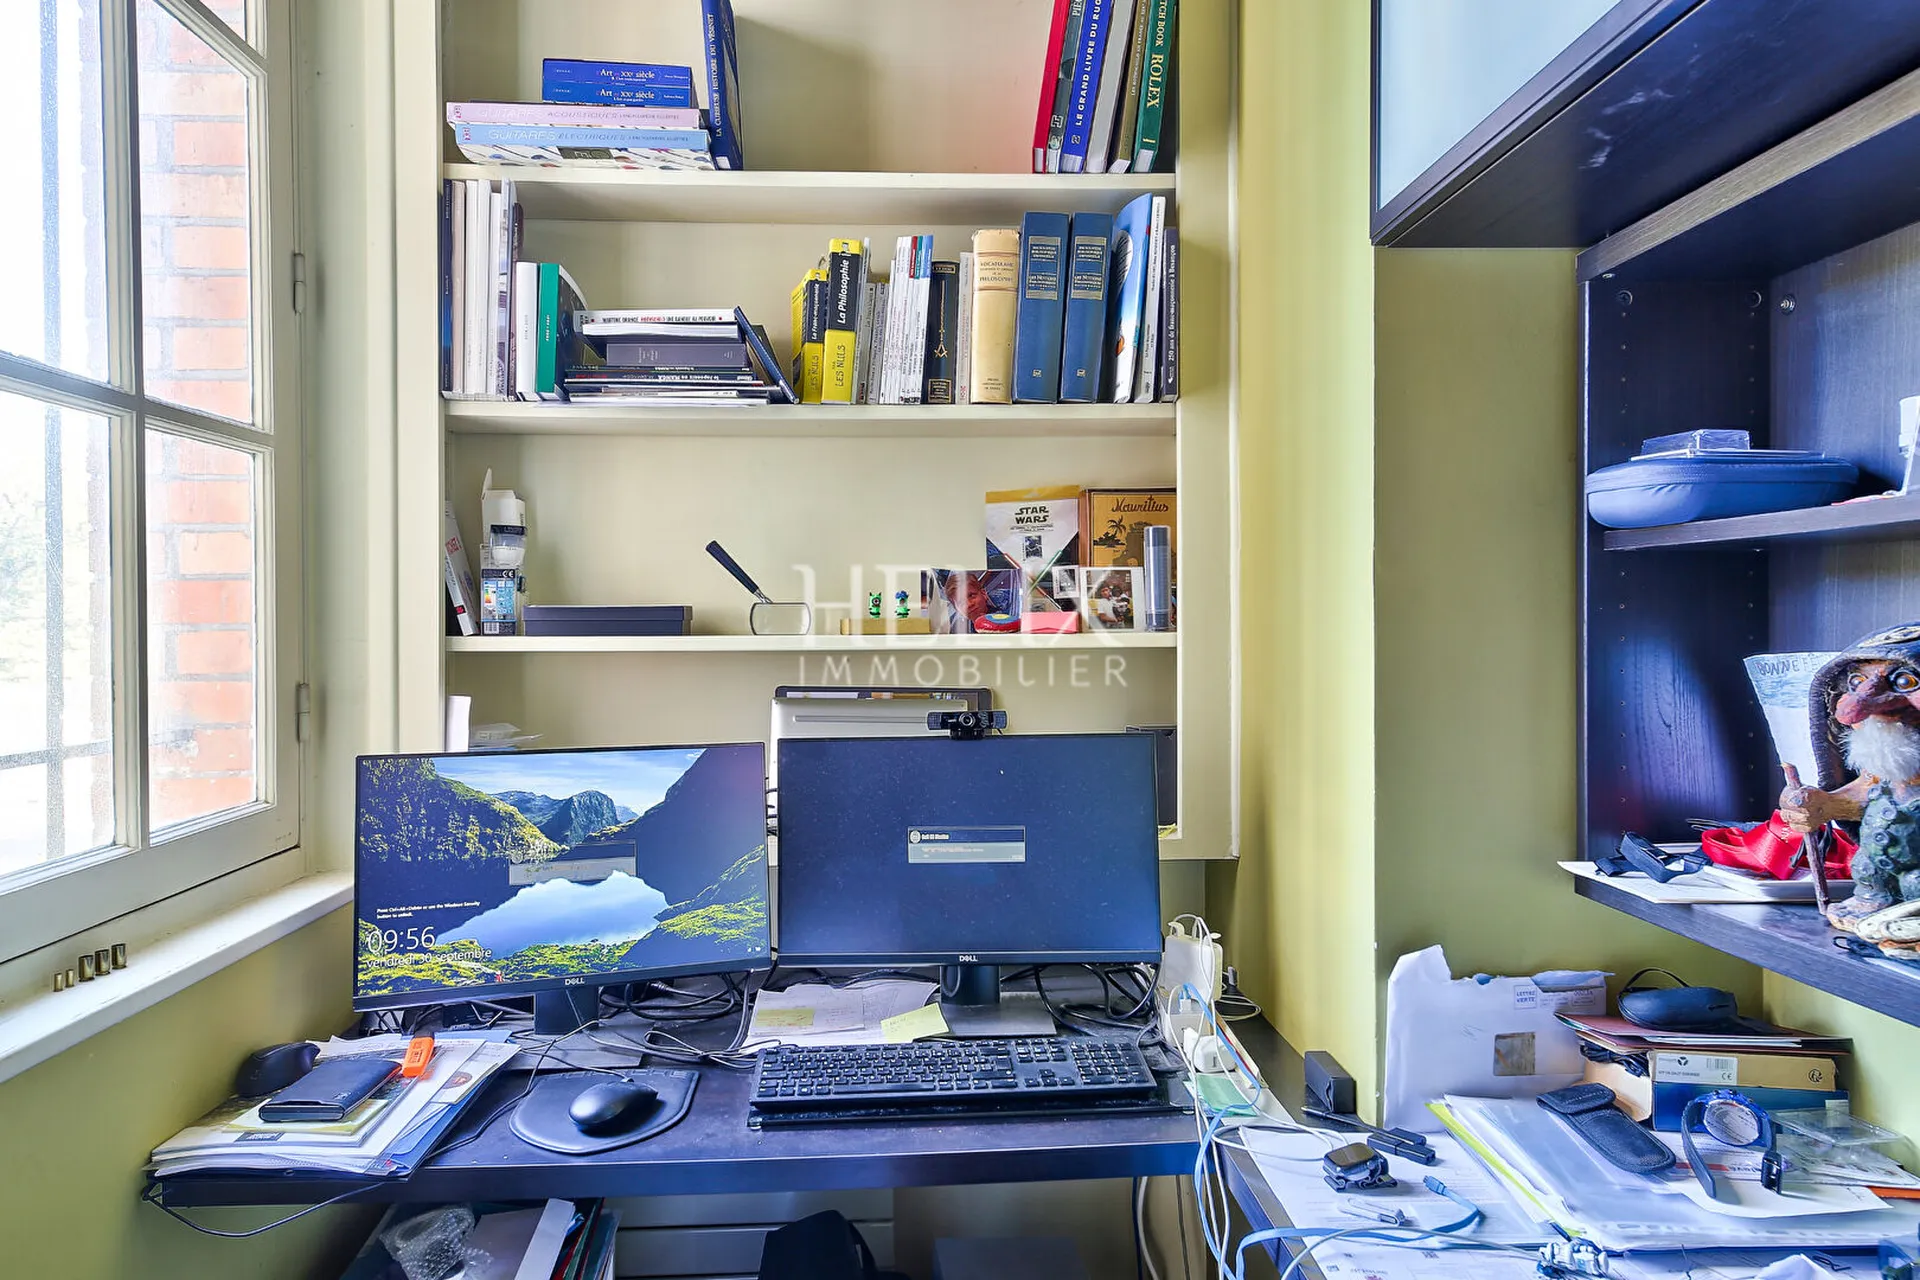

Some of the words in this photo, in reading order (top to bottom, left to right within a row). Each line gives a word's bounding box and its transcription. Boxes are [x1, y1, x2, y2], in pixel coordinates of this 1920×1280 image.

[1089, 23, 1098, 38] DU
[1156, 20, 1166, 46] BOOK
[708, 44, 717, 56] DU
[1084, 40, 1096, 72] LIVRE
[710, 58, 720, 90] HISTOIRE
[1146, 54, 1164, 108] ROLEX
[1078, 74, 1090, 111] GRAND
[1075, 114, 1083, 126] LE
[488, 130, 556, 141] GUITARES
[838, 259, 850, 310] Philosophie
[838, 311, 846, 324] La
[836, 344, 846, 368] NULS
[1168, 351, 1176, 362] 250
[835, 371, 845, 387] LES
[1014, 506, 1049, 516] STAR
[1112, 494, 1169, 513] Mauritius
[1016, 515, 1049, 524] WARS
[1754, 660, 1800, 676] BONNE
[368, 926, 436, 955] 09:56
[366, 954, 415, 968] vendredi
[418, 952, 432, 964] 30
[436, 948, 492, 963] septembre
[564, 977, 585, 985] DELL
